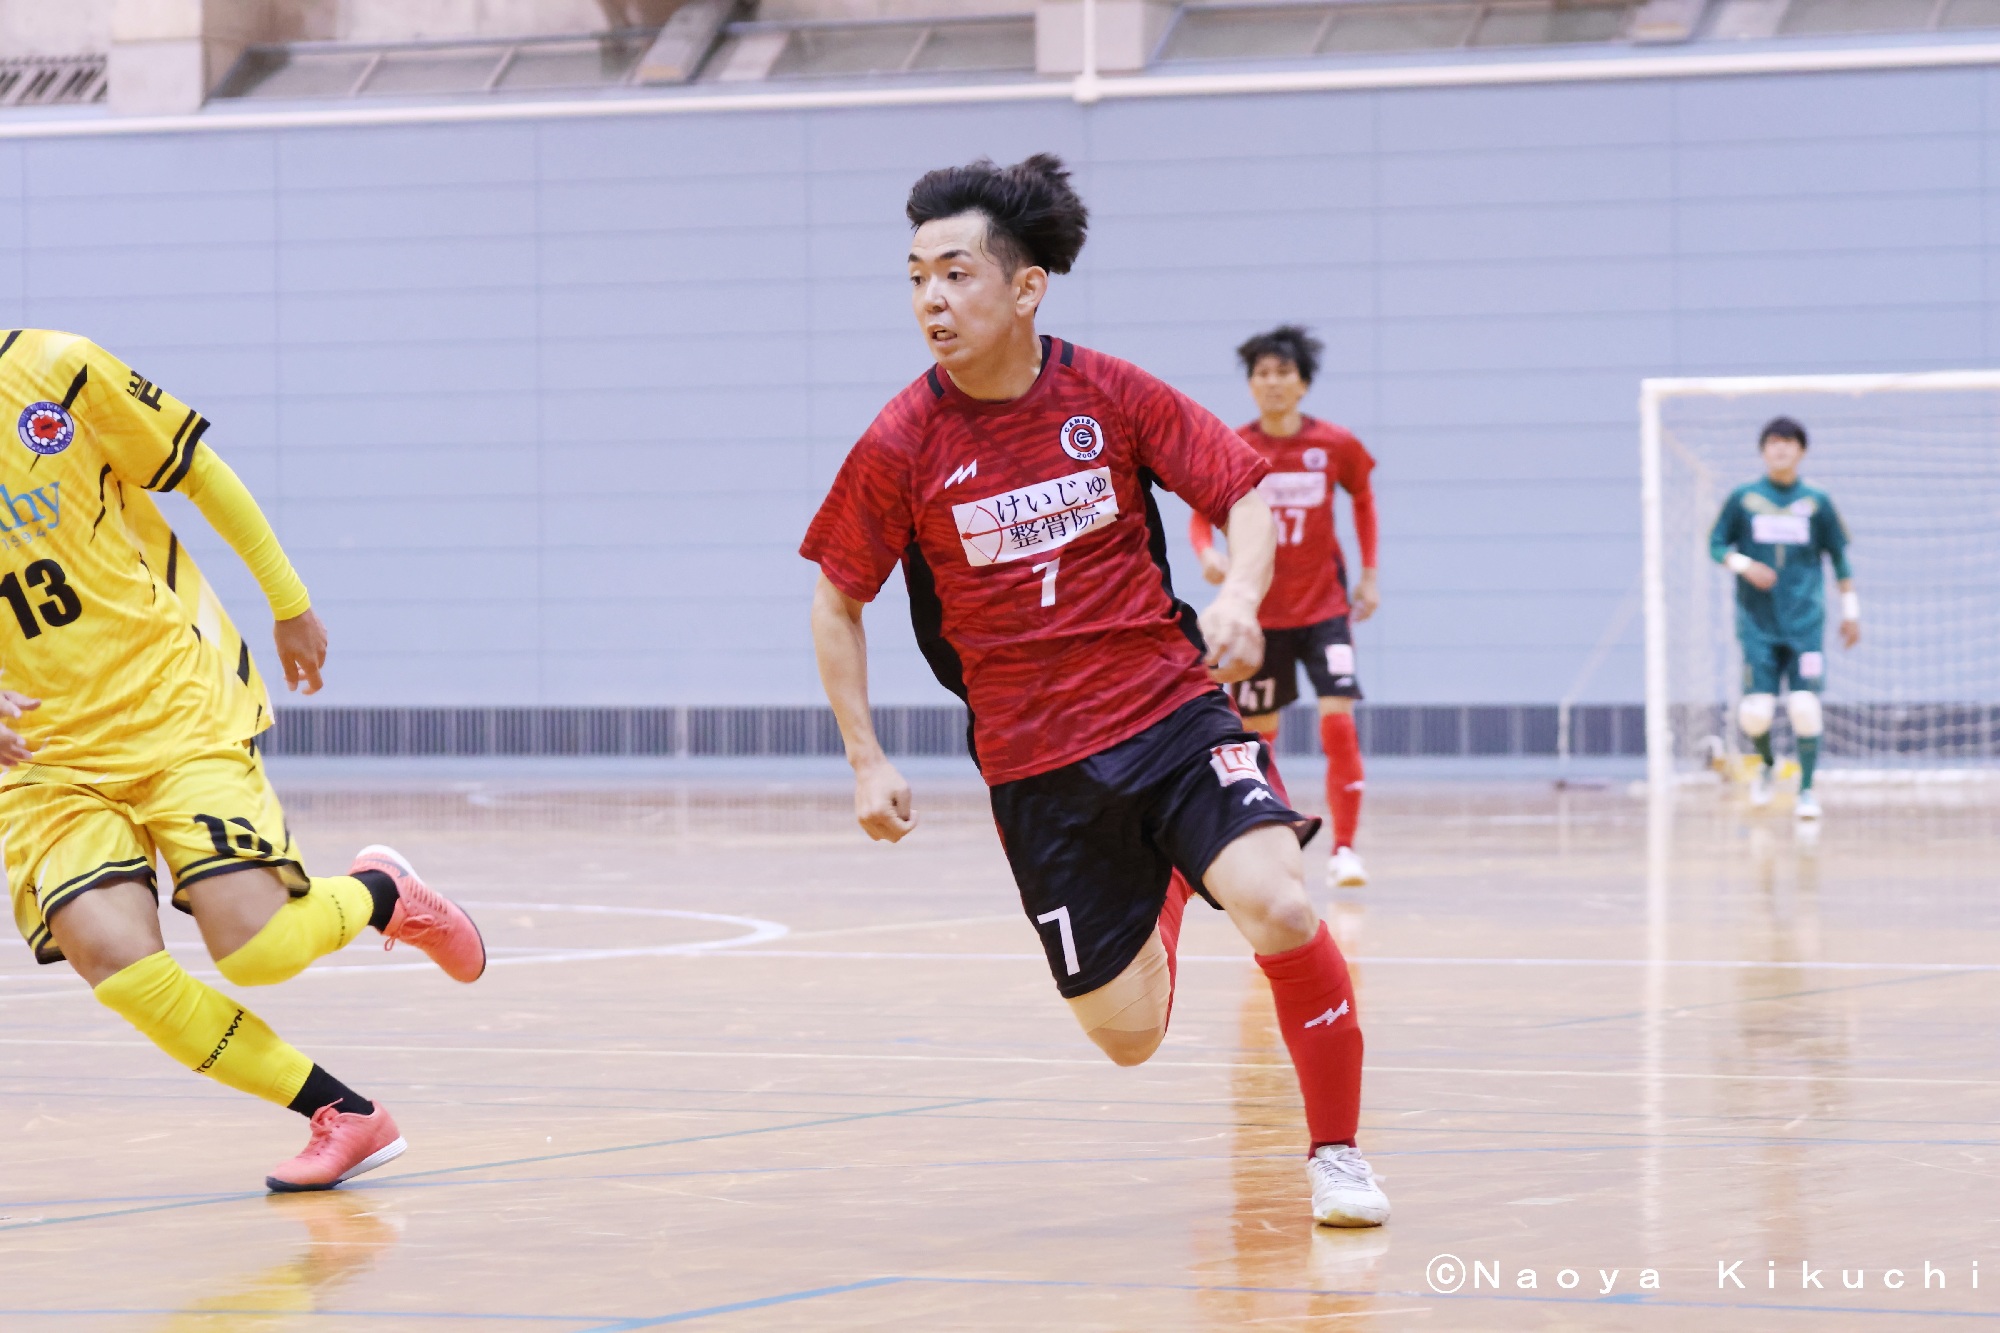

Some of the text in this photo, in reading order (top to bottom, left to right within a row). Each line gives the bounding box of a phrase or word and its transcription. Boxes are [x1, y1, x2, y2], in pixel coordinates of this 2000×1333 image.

[1064, 418, 1095, 433] CAMISA
[1076, 449, 1098, 459] 2002
[0, 481, 60, 532] hy
[995, 476, 1107, 522] けいじゅ
[1009, 498, 1100, 550] 整骨院
[0, 558, 82, 640] 13
[1032, 557, 1060, 608] 7
[1036, 905, 1081, 976] 7
